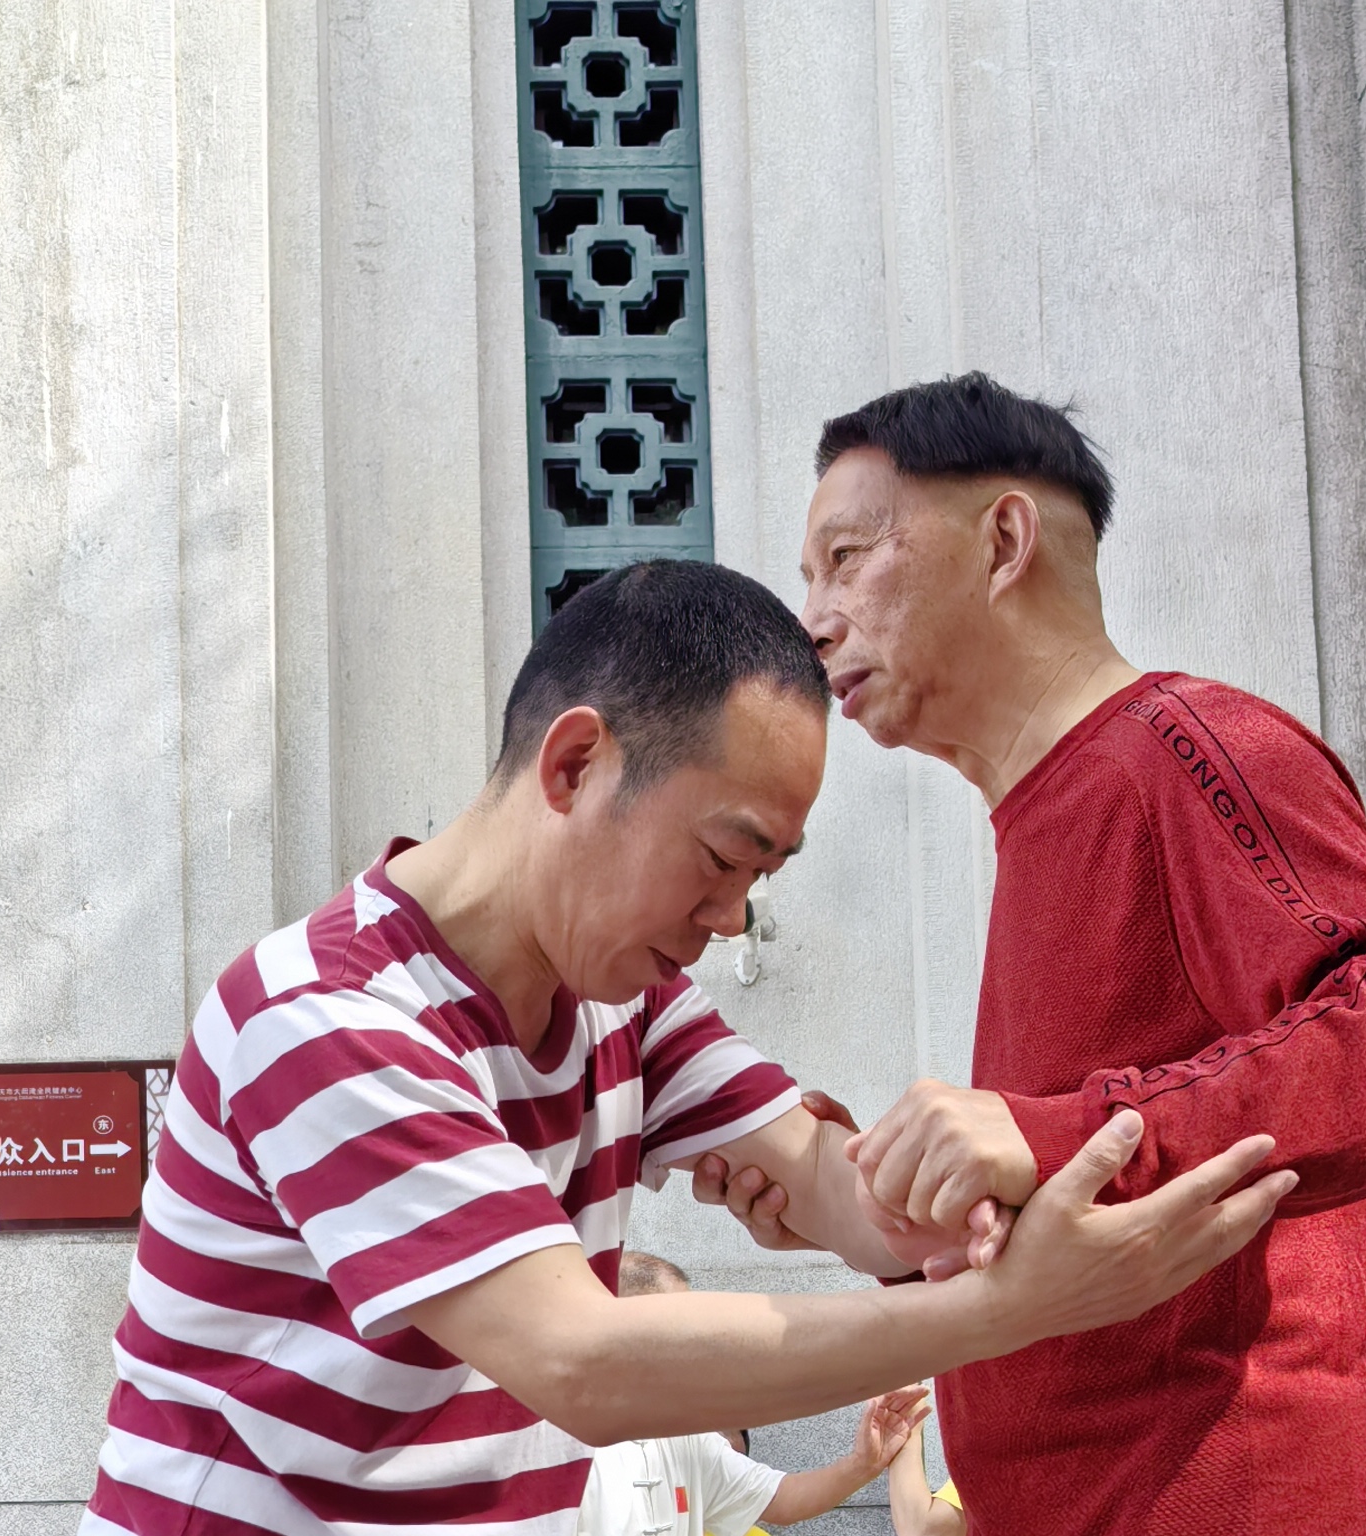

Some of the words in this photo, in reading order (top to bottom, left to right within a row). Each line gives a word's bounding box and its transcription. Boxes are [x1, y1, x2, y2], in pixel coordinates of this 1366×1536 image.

[96, 1118, 110, 1132] 东
[35, 1167, 79, 1176] entrance
[94, 1166, 116, 1175] East
